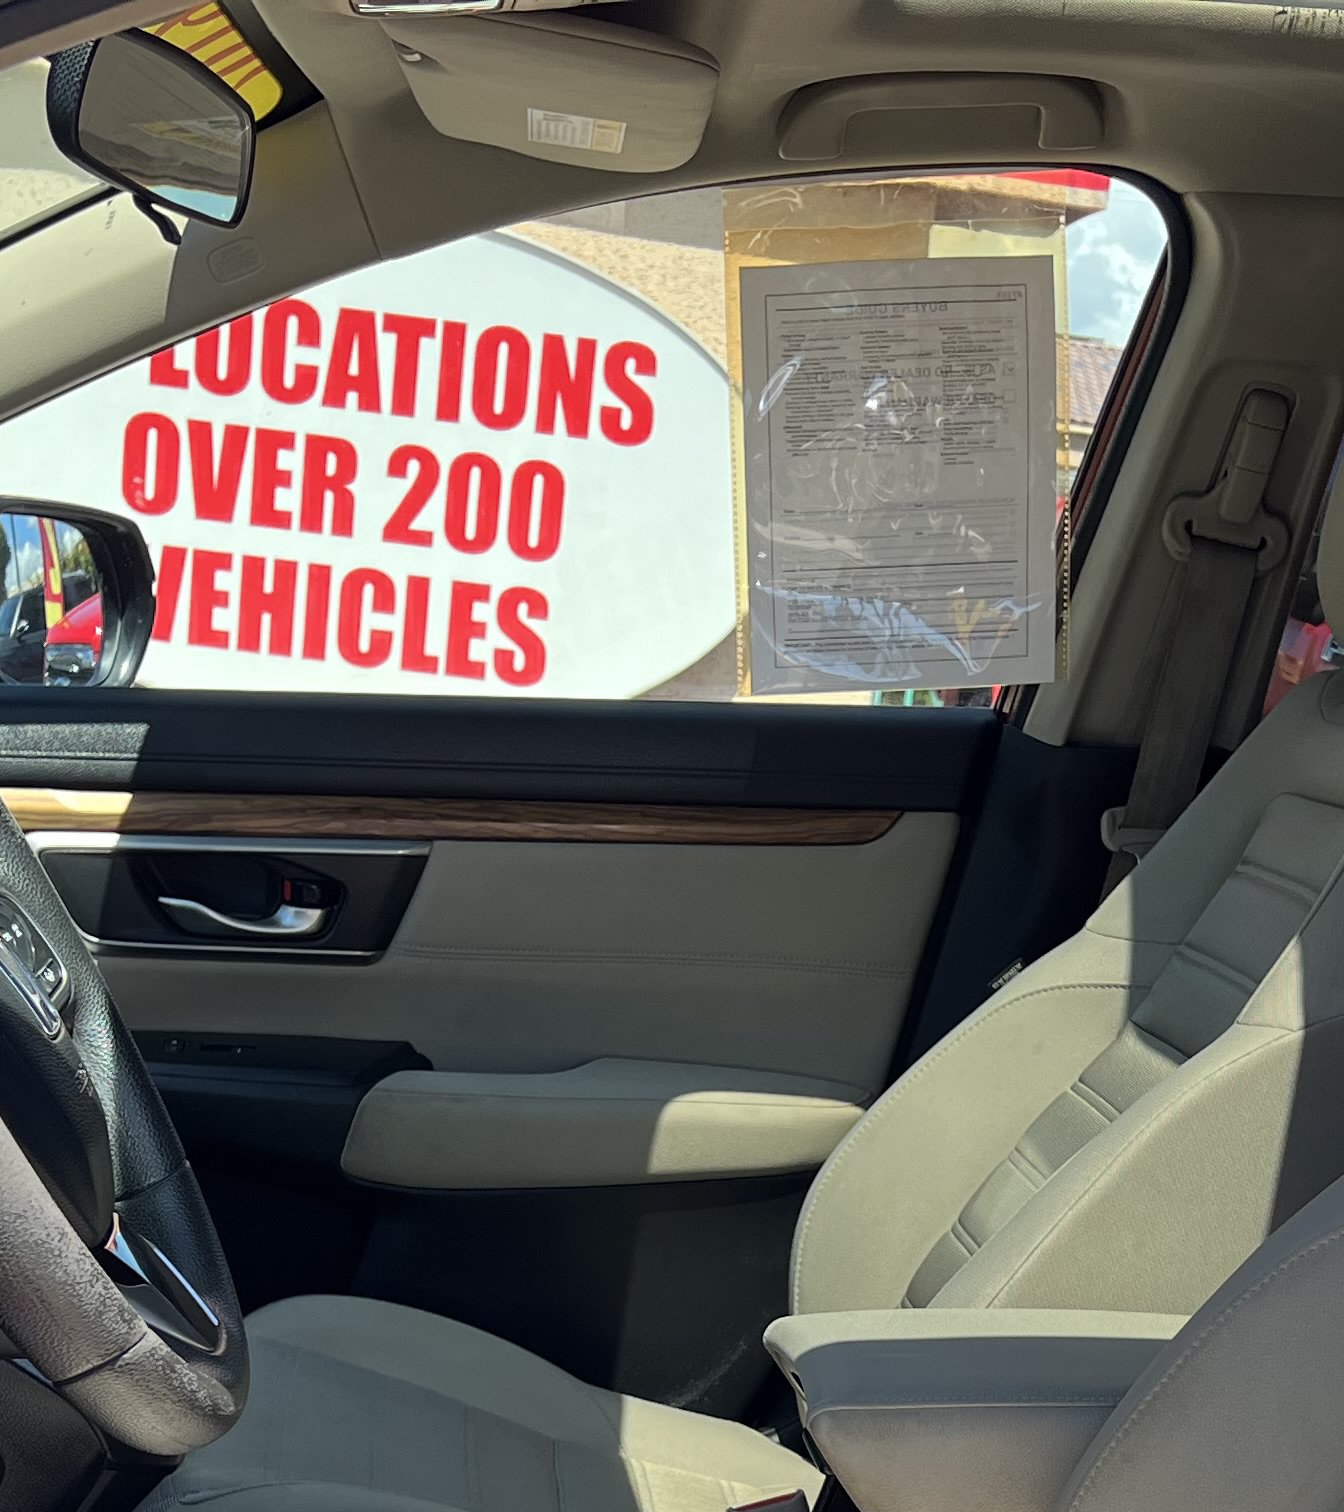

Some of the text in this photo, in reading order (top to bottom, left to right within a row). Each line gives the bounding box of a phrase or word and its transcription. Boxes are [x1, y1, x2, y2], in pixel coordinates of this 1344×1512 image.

[122, 412, 565, 562] OVER 200
[153, 545, 548, 687] VEHICLES
